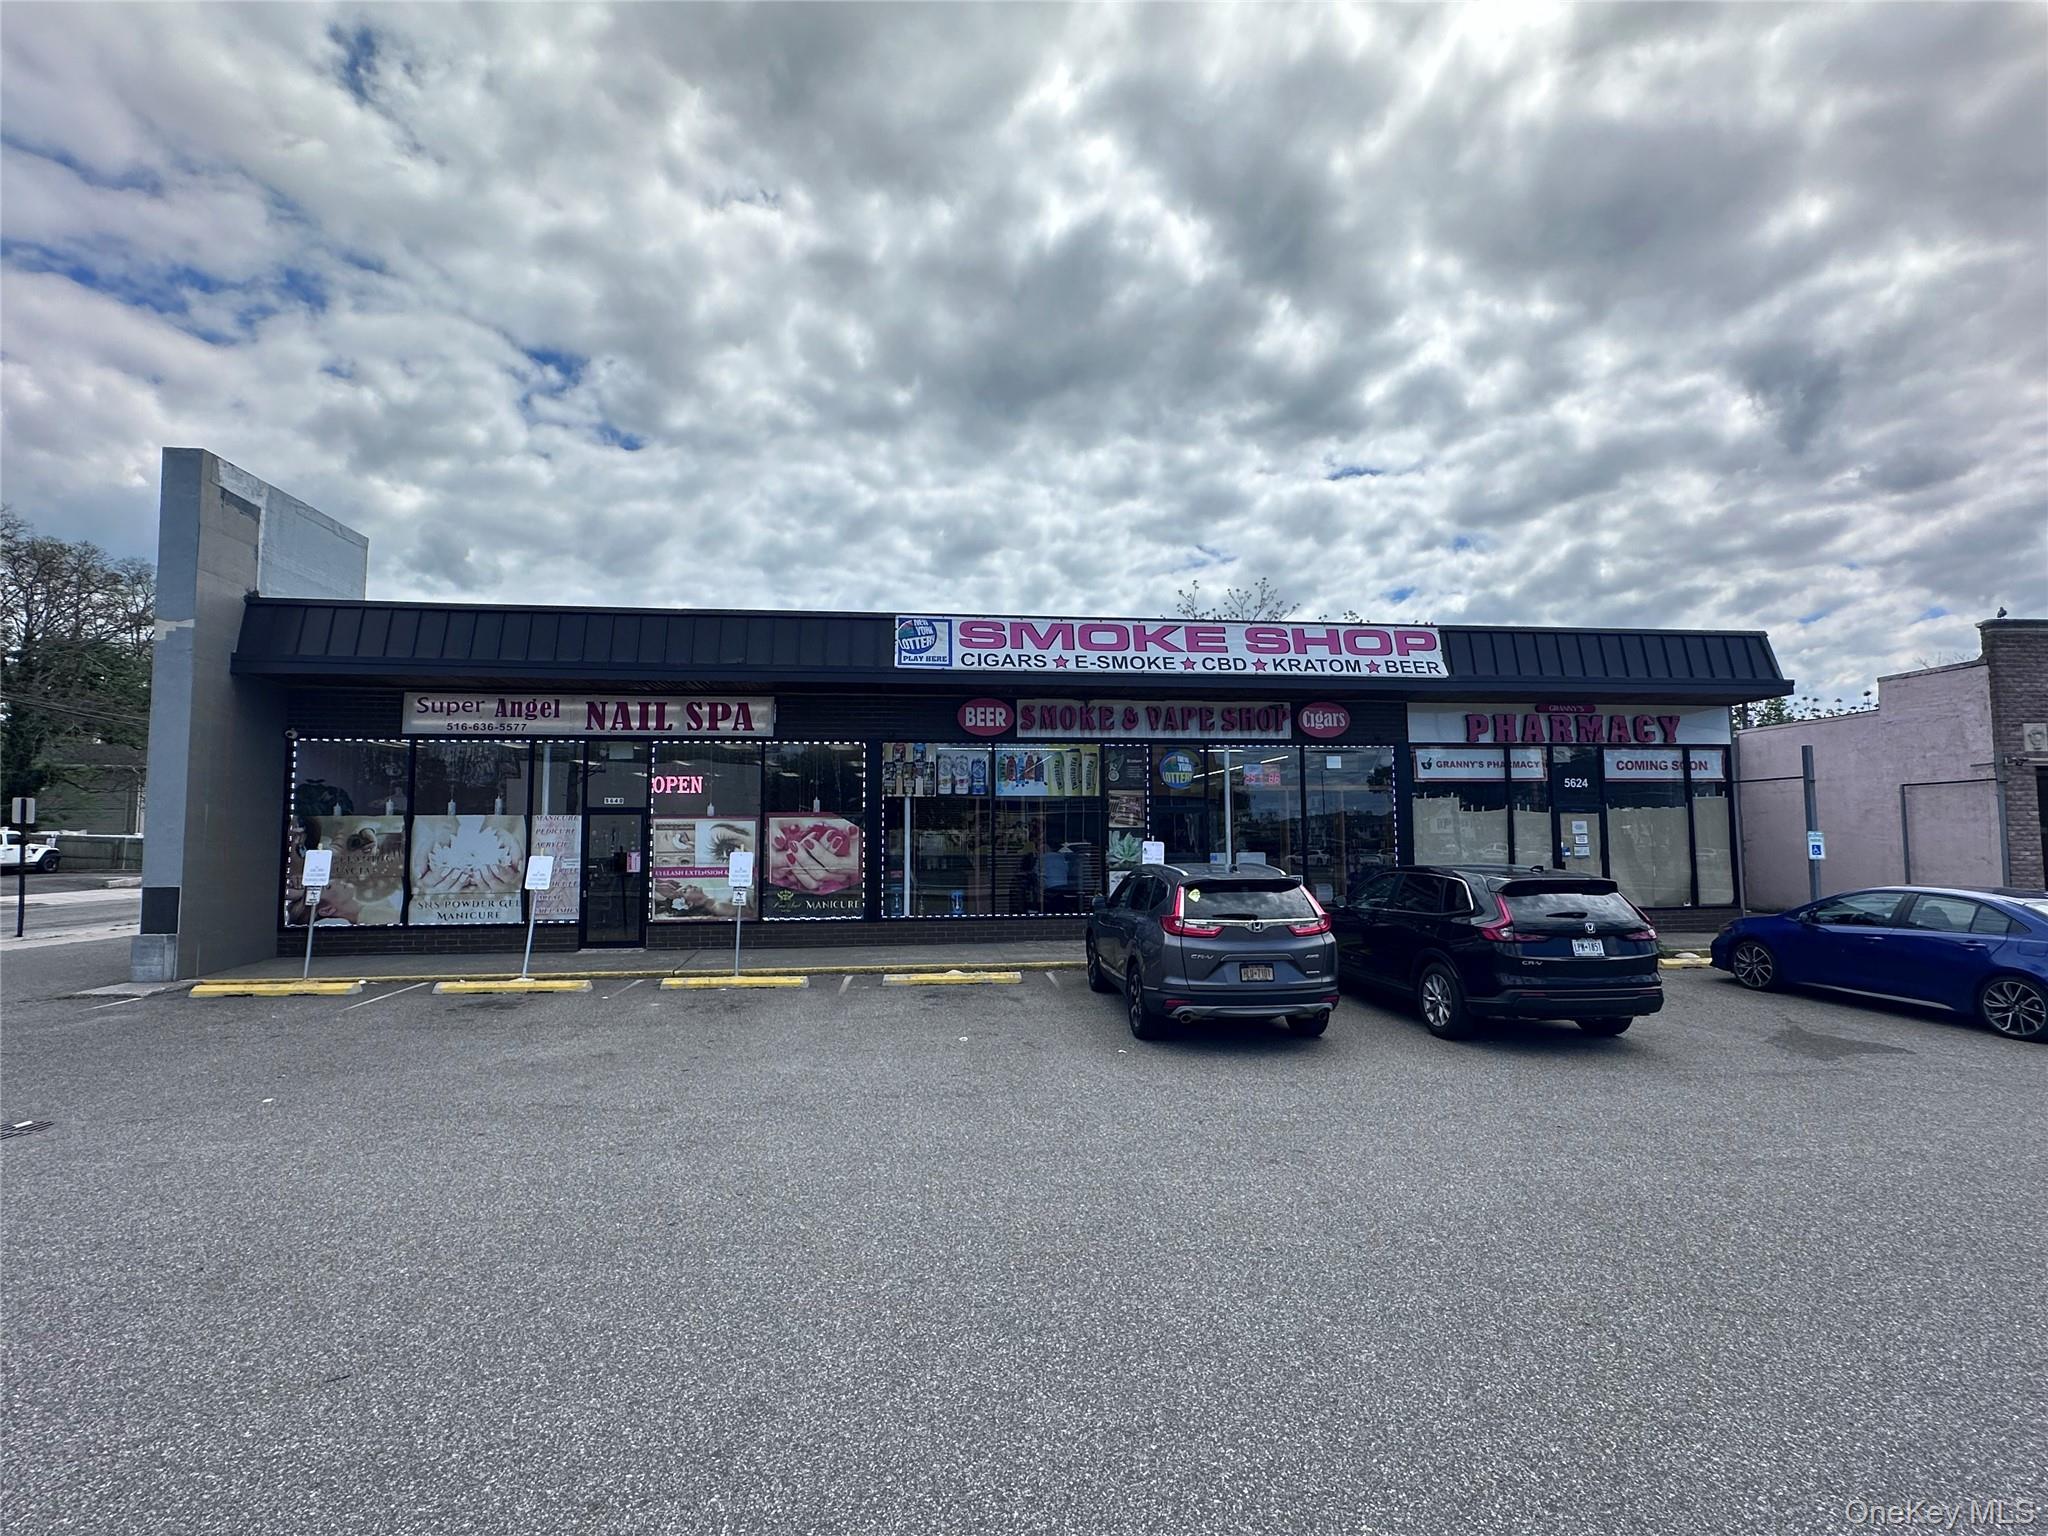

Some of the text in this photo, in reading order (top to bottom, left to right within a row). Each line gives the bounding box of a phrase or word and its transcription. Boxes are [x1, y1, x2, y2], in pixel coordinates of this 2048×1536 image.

[959, 620, 1437, 656] SMOKE SHOP
[926, 655, 947, 663] HERE
[960, 653, 1441, 674] CIGARS E-SMOKE CBD KRATOM BEER
[416, 697, 560, 720] Super Angel
[585, 701, 755, 731] NAIL SPA
[965, 707, 1006, 727] BEER
[1020, 704, 1289, 731] SMOKE & VAPE SHOP
[446, 722, 527, 731] 516-636-5577
[1302, 710, 1346, 729] Cigars
[1465, 714, 1680, 743] PHARMACY
[1436, 760, 1484, 769] GRANNY'S
[1616, 760, 1668, 770] COMING
[653, 776, 703, 794] OPEN
[1564, 778, 1588, 788] 5624
[445, 900, 494, 908] POWDER
[806, 900, 859, 910] MANICURE
[436, 911, 500, 920] MANICURE
